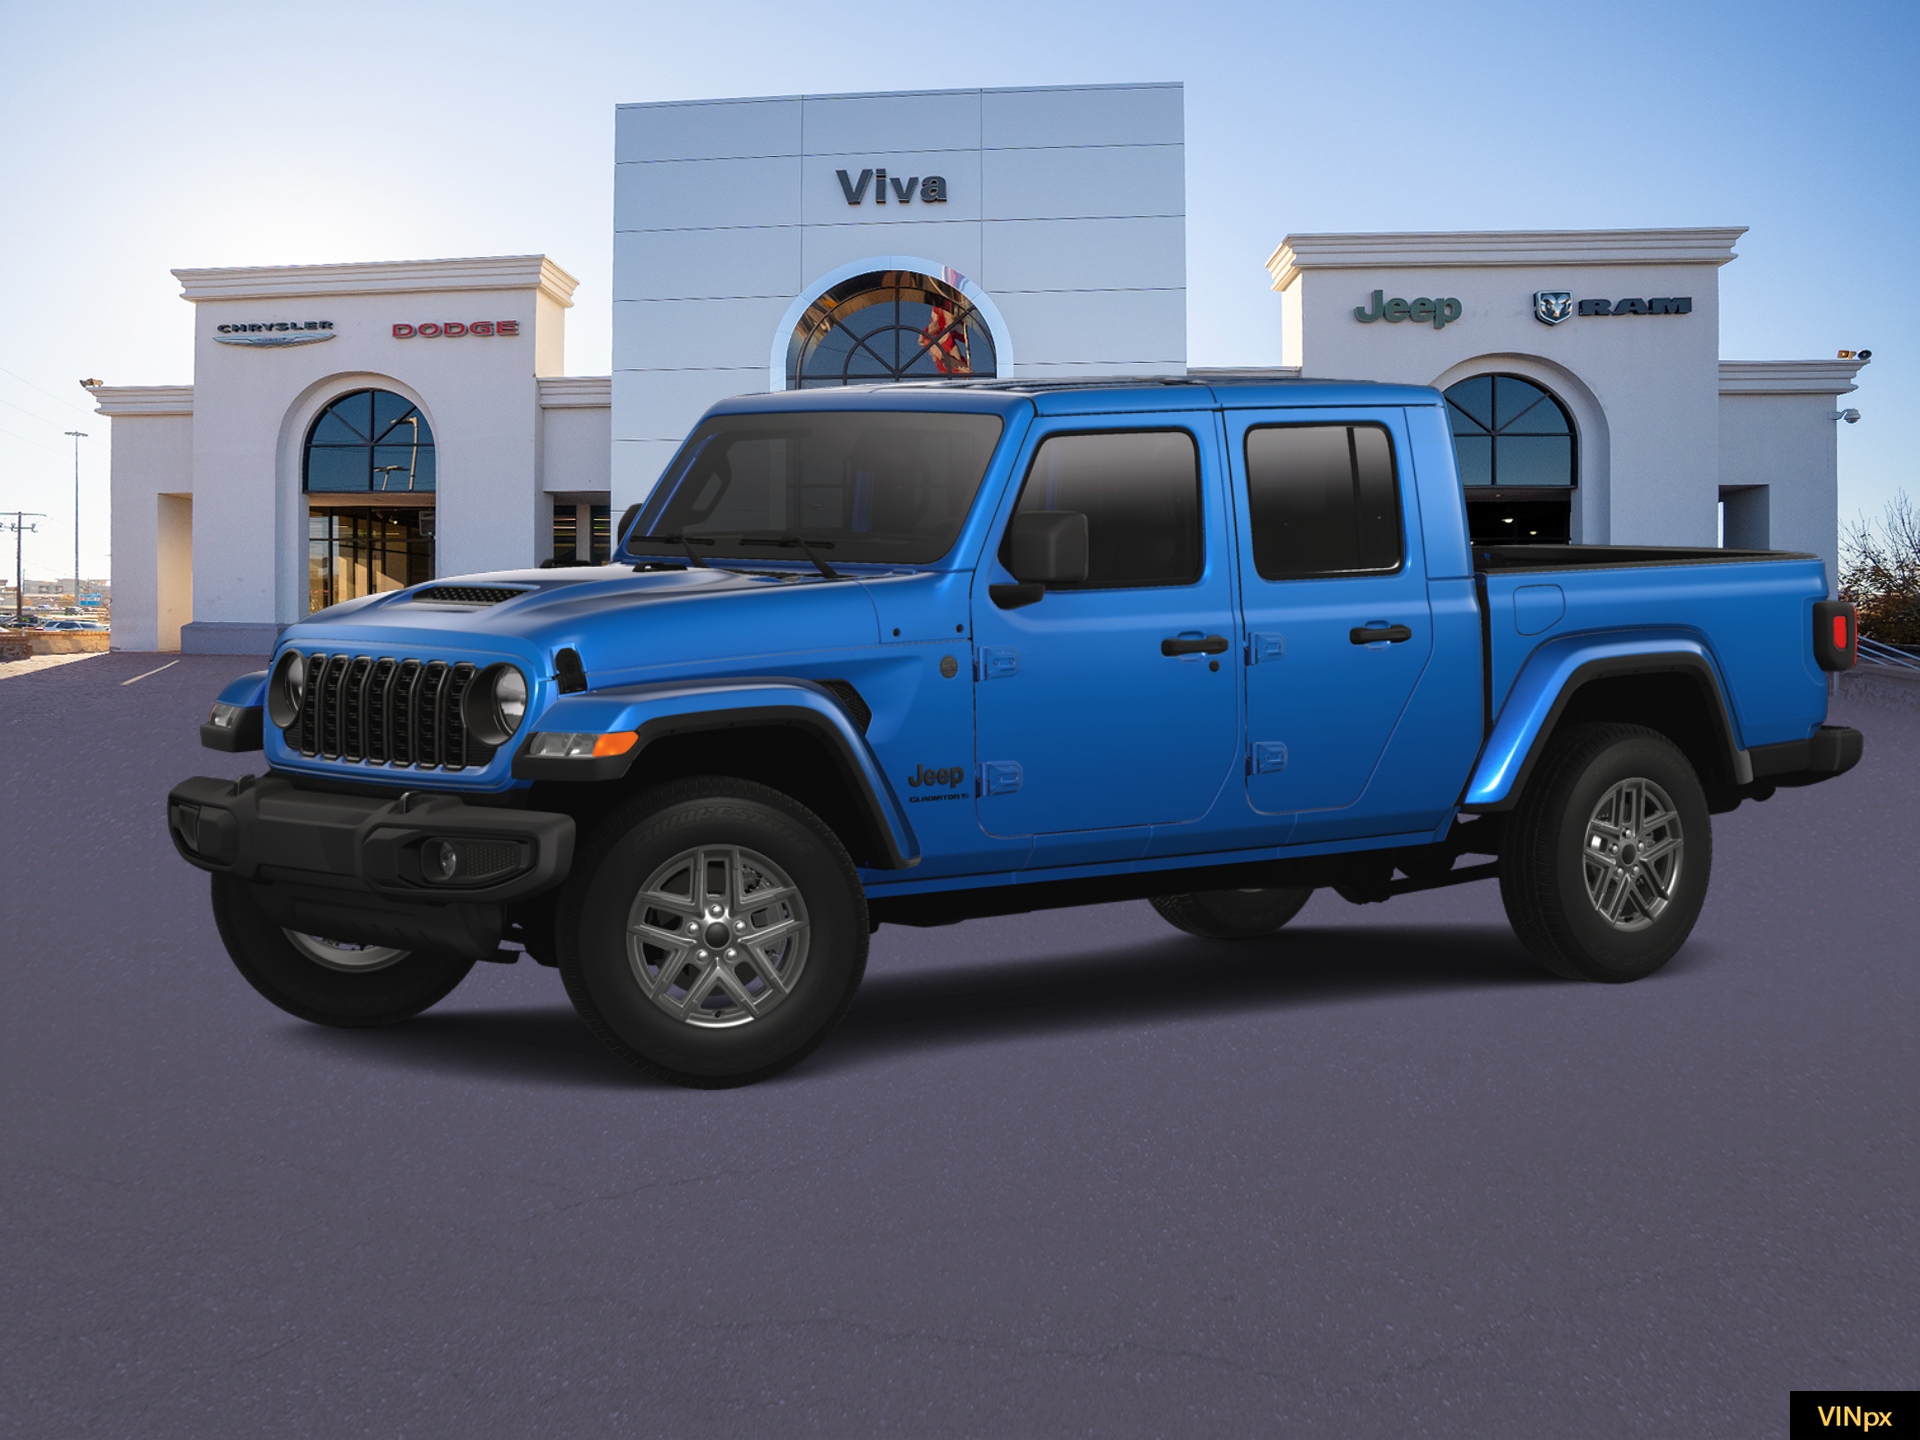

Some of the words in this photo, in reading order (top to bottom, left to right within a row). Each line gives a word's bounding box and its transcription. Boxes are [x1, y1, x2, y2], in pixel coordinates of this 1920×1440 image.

[835, 168, 947, 205] Viva
[1354, 289, 1462, 329] Jeep
[1578, 297, 1692, 316] RAM
[217, 321, 333, 333] CHRYSLER
[392, 320, 519, 338] DODGE
[908, 763, 964, 789] Jeep
[909, 793, 960, 803] GLADIATOR
[632, 806, 815, 854] BRIDGESTONE
